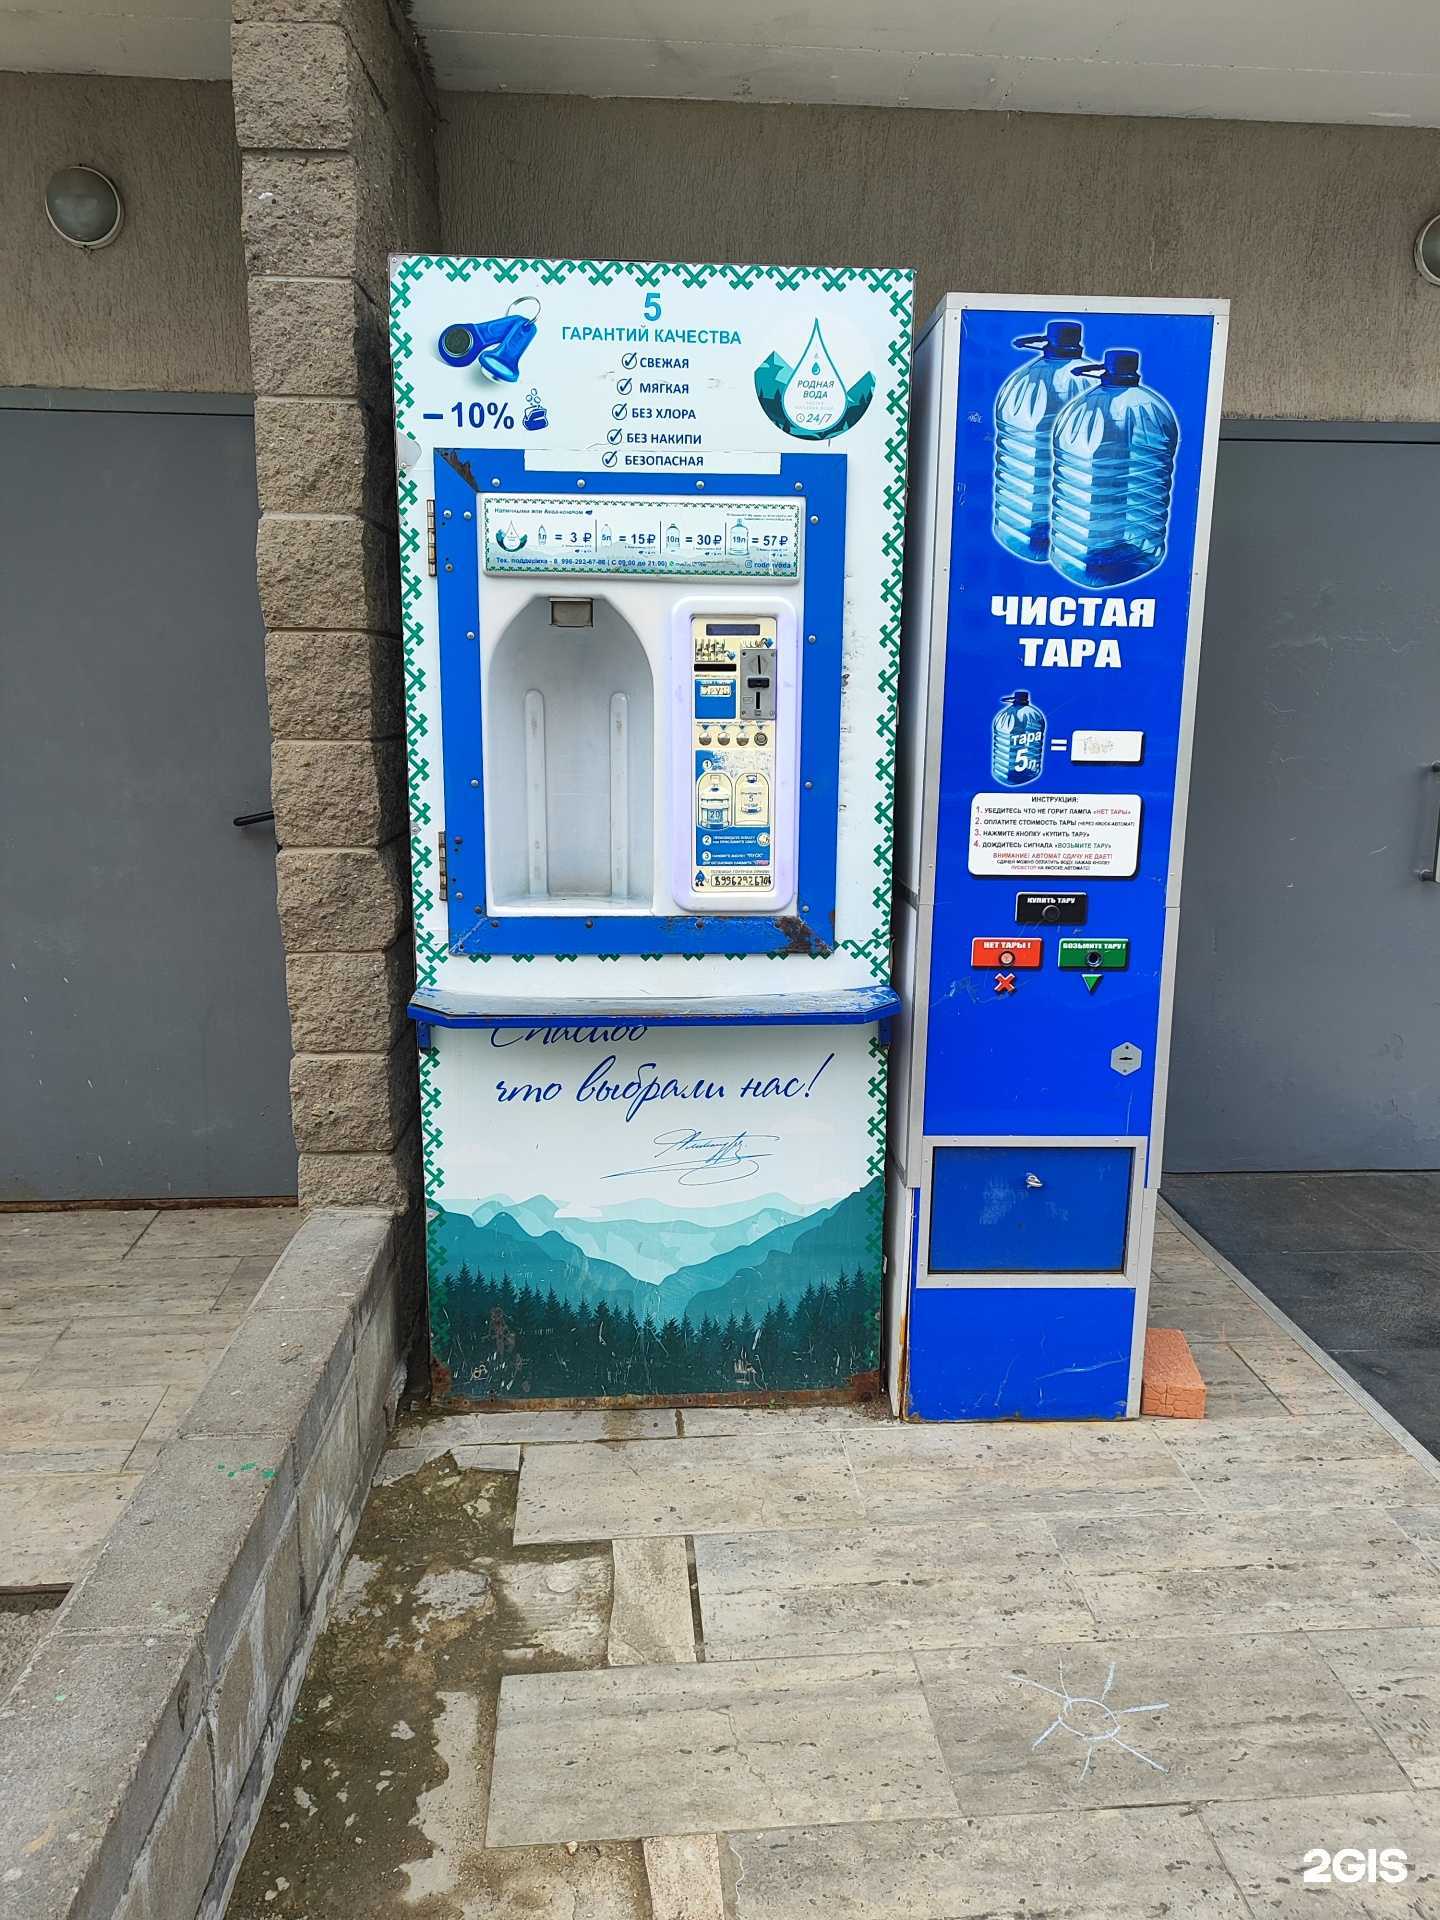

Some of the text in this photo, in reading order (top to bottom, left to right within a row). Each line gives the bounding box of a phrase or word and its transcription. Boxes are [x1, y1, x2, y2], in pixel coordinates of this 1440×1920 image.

[643, 291, 663, 322] 5
[561, 324, 742, 345] ГАРАНТИЙ КАЧЕСТВА
[639, 357, 690, 369] СВЕЖАЯ
[639, 382, 690, 395] МЯГКАЯ
[797, 380, 835, 389] РОДНАЯ
[803, 390, 828, 400] ВОДА
[451, 401, 515, 430] 10%
[631, 407, 697, 420] БЕЗ ХЛОРА
[806, 413, 833, 425] 24/7
[626, 432, 702, 445] БЕЗ НАКИПИ
[624, 455, 704, 467] БЕЗОПАСНАЯ
[570, 531, 578, 543] 3
[763, 535, 778, 547] 57
[991, 596, 1156, 628] ЧИСТАЯ
[1019, 638, 1122, 668] ТАРА
[1010, 731, 1042, 748] тара
[1014, 748, 1029, 772] 5
[1031, 796, 1079, 804] ИНСТРУКЦИЯ:
[982, 841, 1022, 849] ДОЖДИТЕСЬ
[1027, 897, 1056, 905] КУПИТЬ
[983, 941, 1001, 949] НЕТ
[495, 1052, 836, 1122] что выбрали нас!
